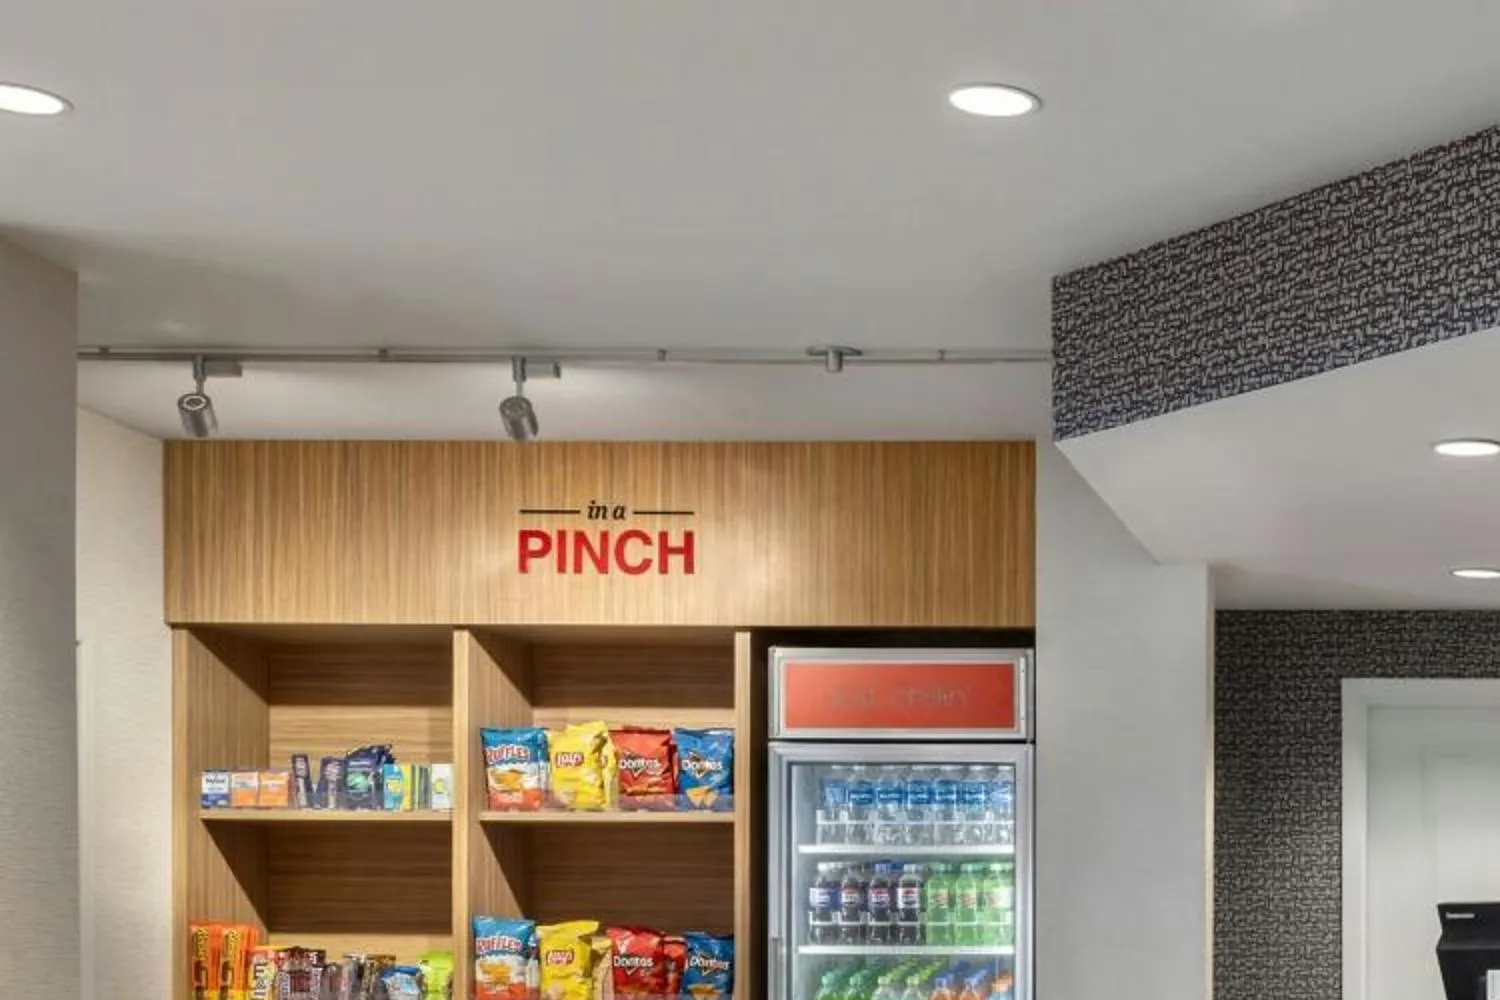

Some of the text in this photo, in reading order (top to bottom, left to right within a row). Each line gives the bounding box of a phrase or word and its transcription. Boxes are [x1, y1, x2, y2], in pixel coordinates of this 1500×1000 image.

[587, 500, 627, 520] in a
[518, 529, 695, 575] PINCH
